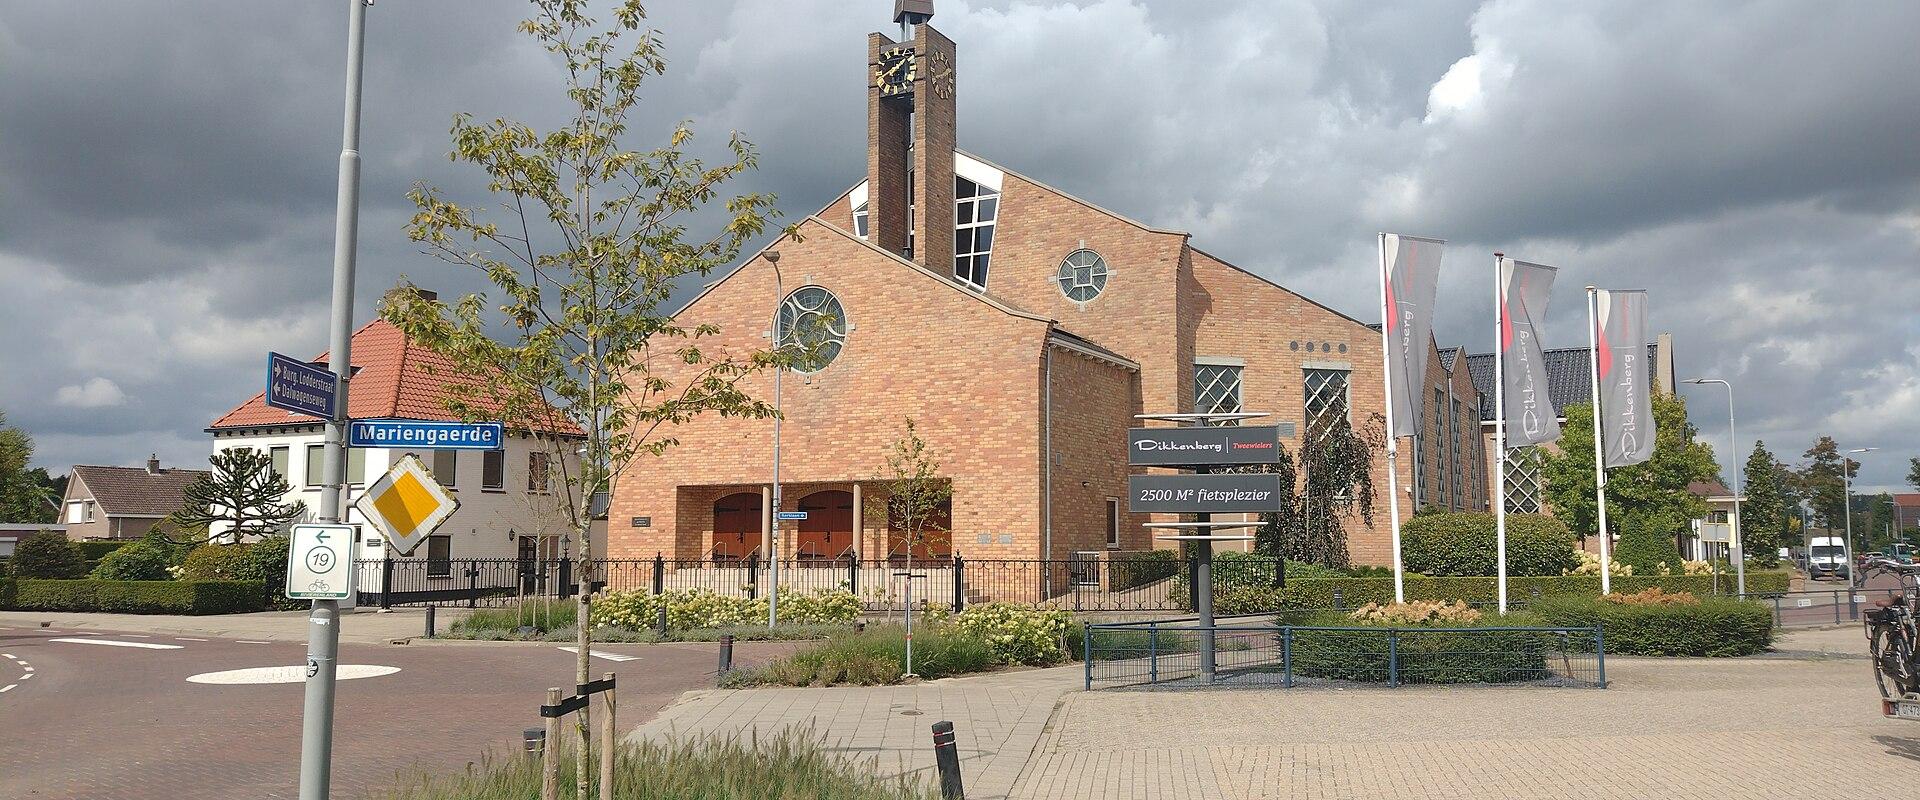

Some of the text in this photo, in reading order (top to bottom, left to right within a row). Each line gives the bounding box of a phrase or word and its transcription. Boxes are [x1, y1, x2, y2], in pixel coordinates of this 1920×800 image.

[283, 365, 334, 394] Burg. Lodderstraat
[282, 383, 327, 411] Dalwagenseweg
[1620, 353, 1637, 461] Dikkenberg
[359, 424, 492, 445] Mariengaerde
[1133, 439, 1273, 453] Dikkenberg Tweewielers
[1140, 489, 1172, 501] 2500
[1197, 488, 1271, 503] fietsplezier
[312, 552, 330, 567] 19
